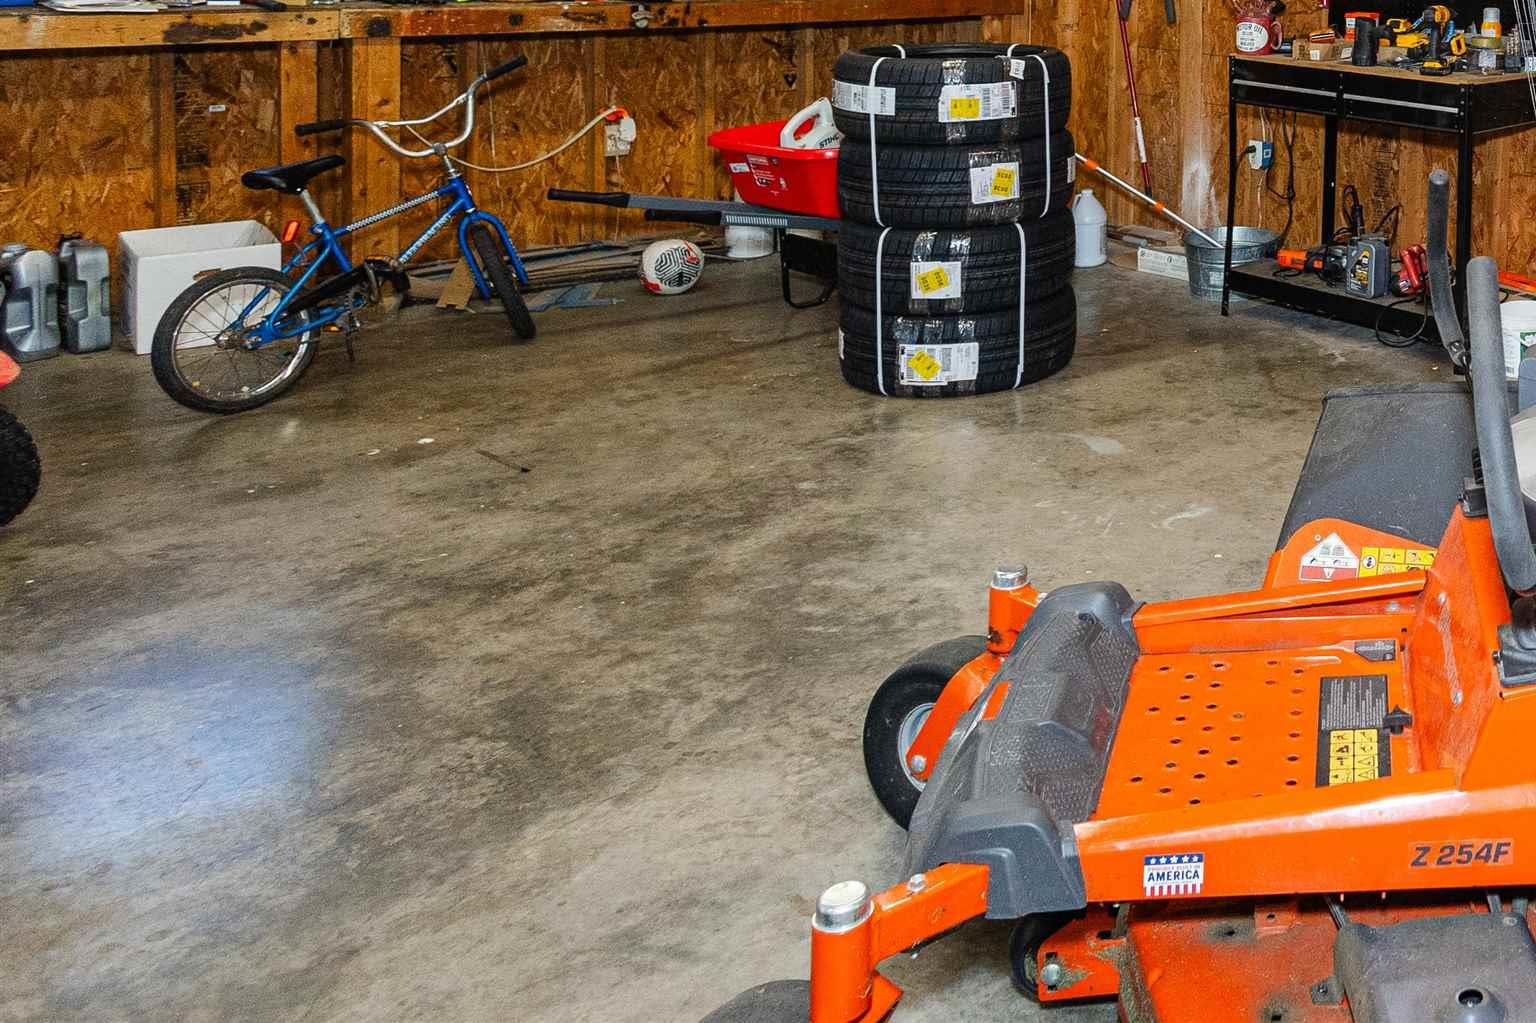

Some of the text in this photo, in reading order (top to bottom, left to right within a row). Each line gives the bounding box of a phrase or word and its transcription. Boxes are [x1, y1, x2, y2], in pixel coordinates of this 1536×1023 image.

[1411, 842, 1511, 867] Z 254F
[1148, 870, 1200, 882] AMERICA
